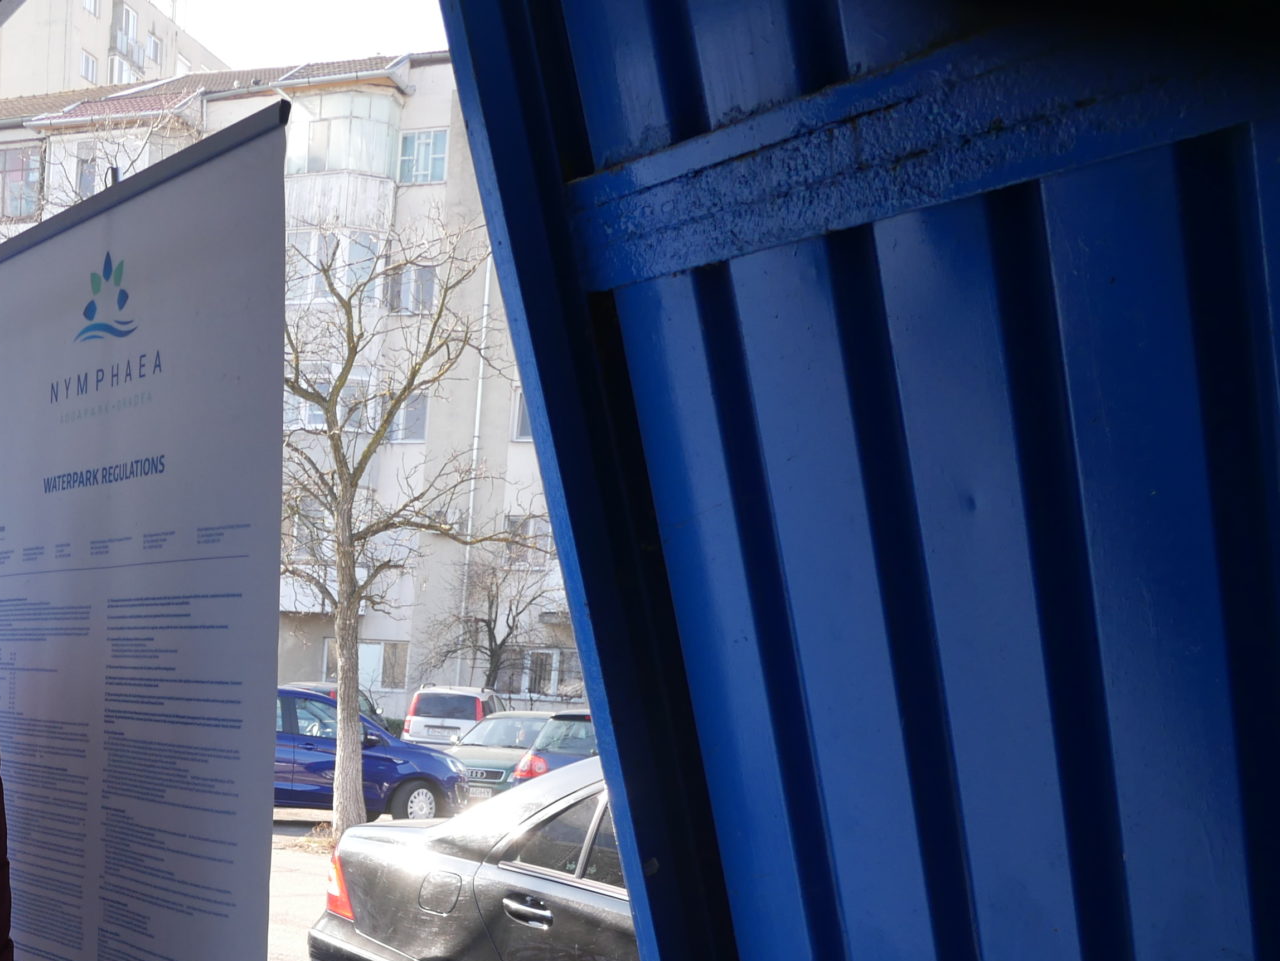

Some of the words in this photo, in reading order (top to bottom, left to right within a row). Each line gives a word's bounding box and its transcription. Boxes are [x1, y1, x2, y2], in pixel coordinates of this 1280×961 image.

[50, 350, 162, 404] NYMPHAEA
[43, 468, 99, 494] WATERPARK
[101, 454, 166, 484] REGULATIONS
